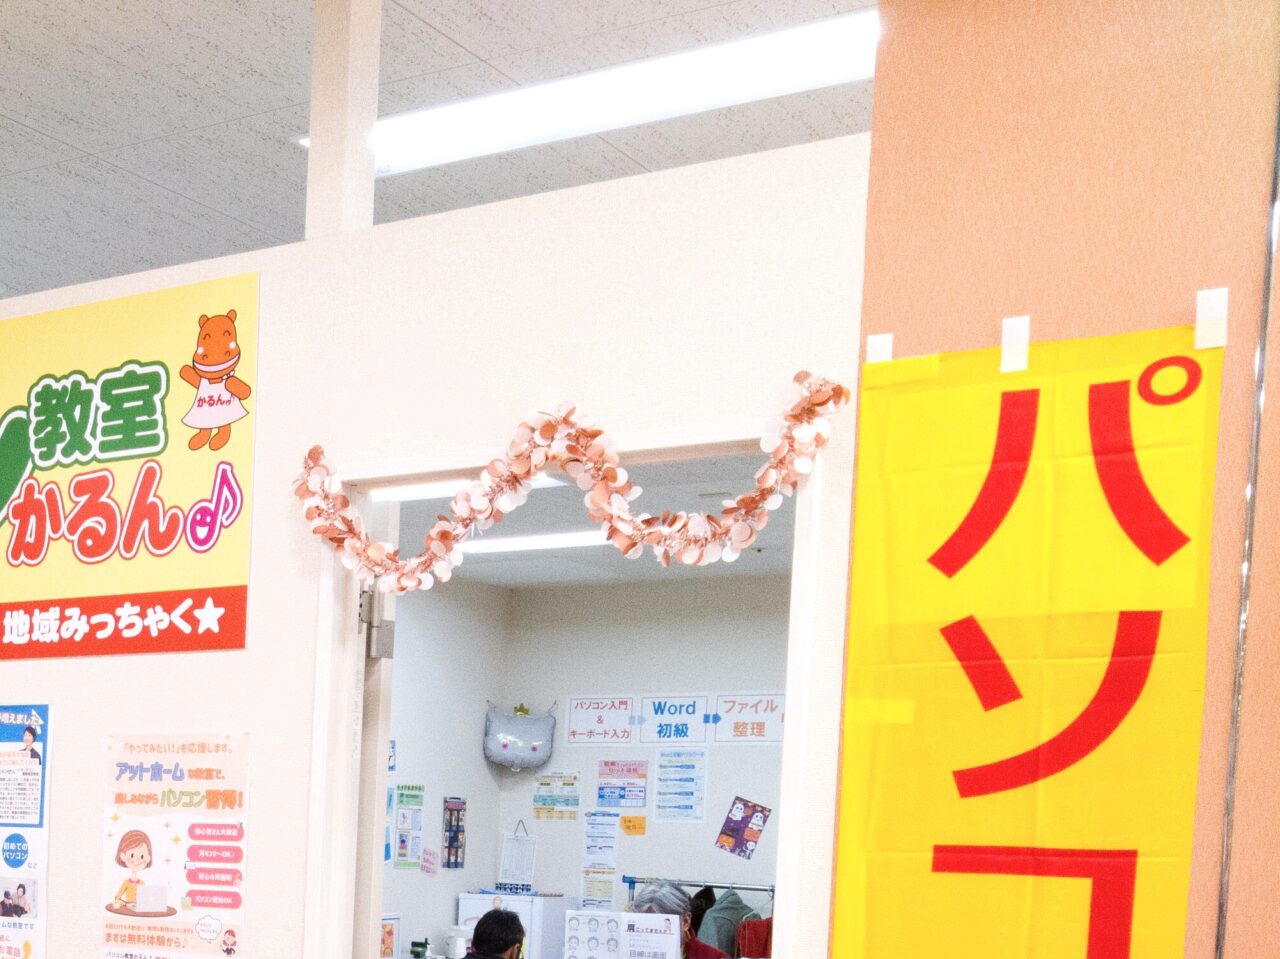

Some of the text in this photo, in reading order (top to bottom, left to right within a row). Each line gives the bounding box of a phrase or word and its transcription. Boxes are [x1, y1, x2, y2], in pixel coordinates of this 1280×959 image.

[26, 359, 170, 470] 教室
[575, 700, 628, 711] パソコン入門
[652, 701, 696, 715] Word
[723, 699, 778, 714] ファイル
[596, 716, 604, 724] &
[570, 729, 630, 739] キーボード入力
[657, 723, 689, 738] 初級
[733, 722, 766, 737] 整理
[3, 851, 27, 861] パソコン
